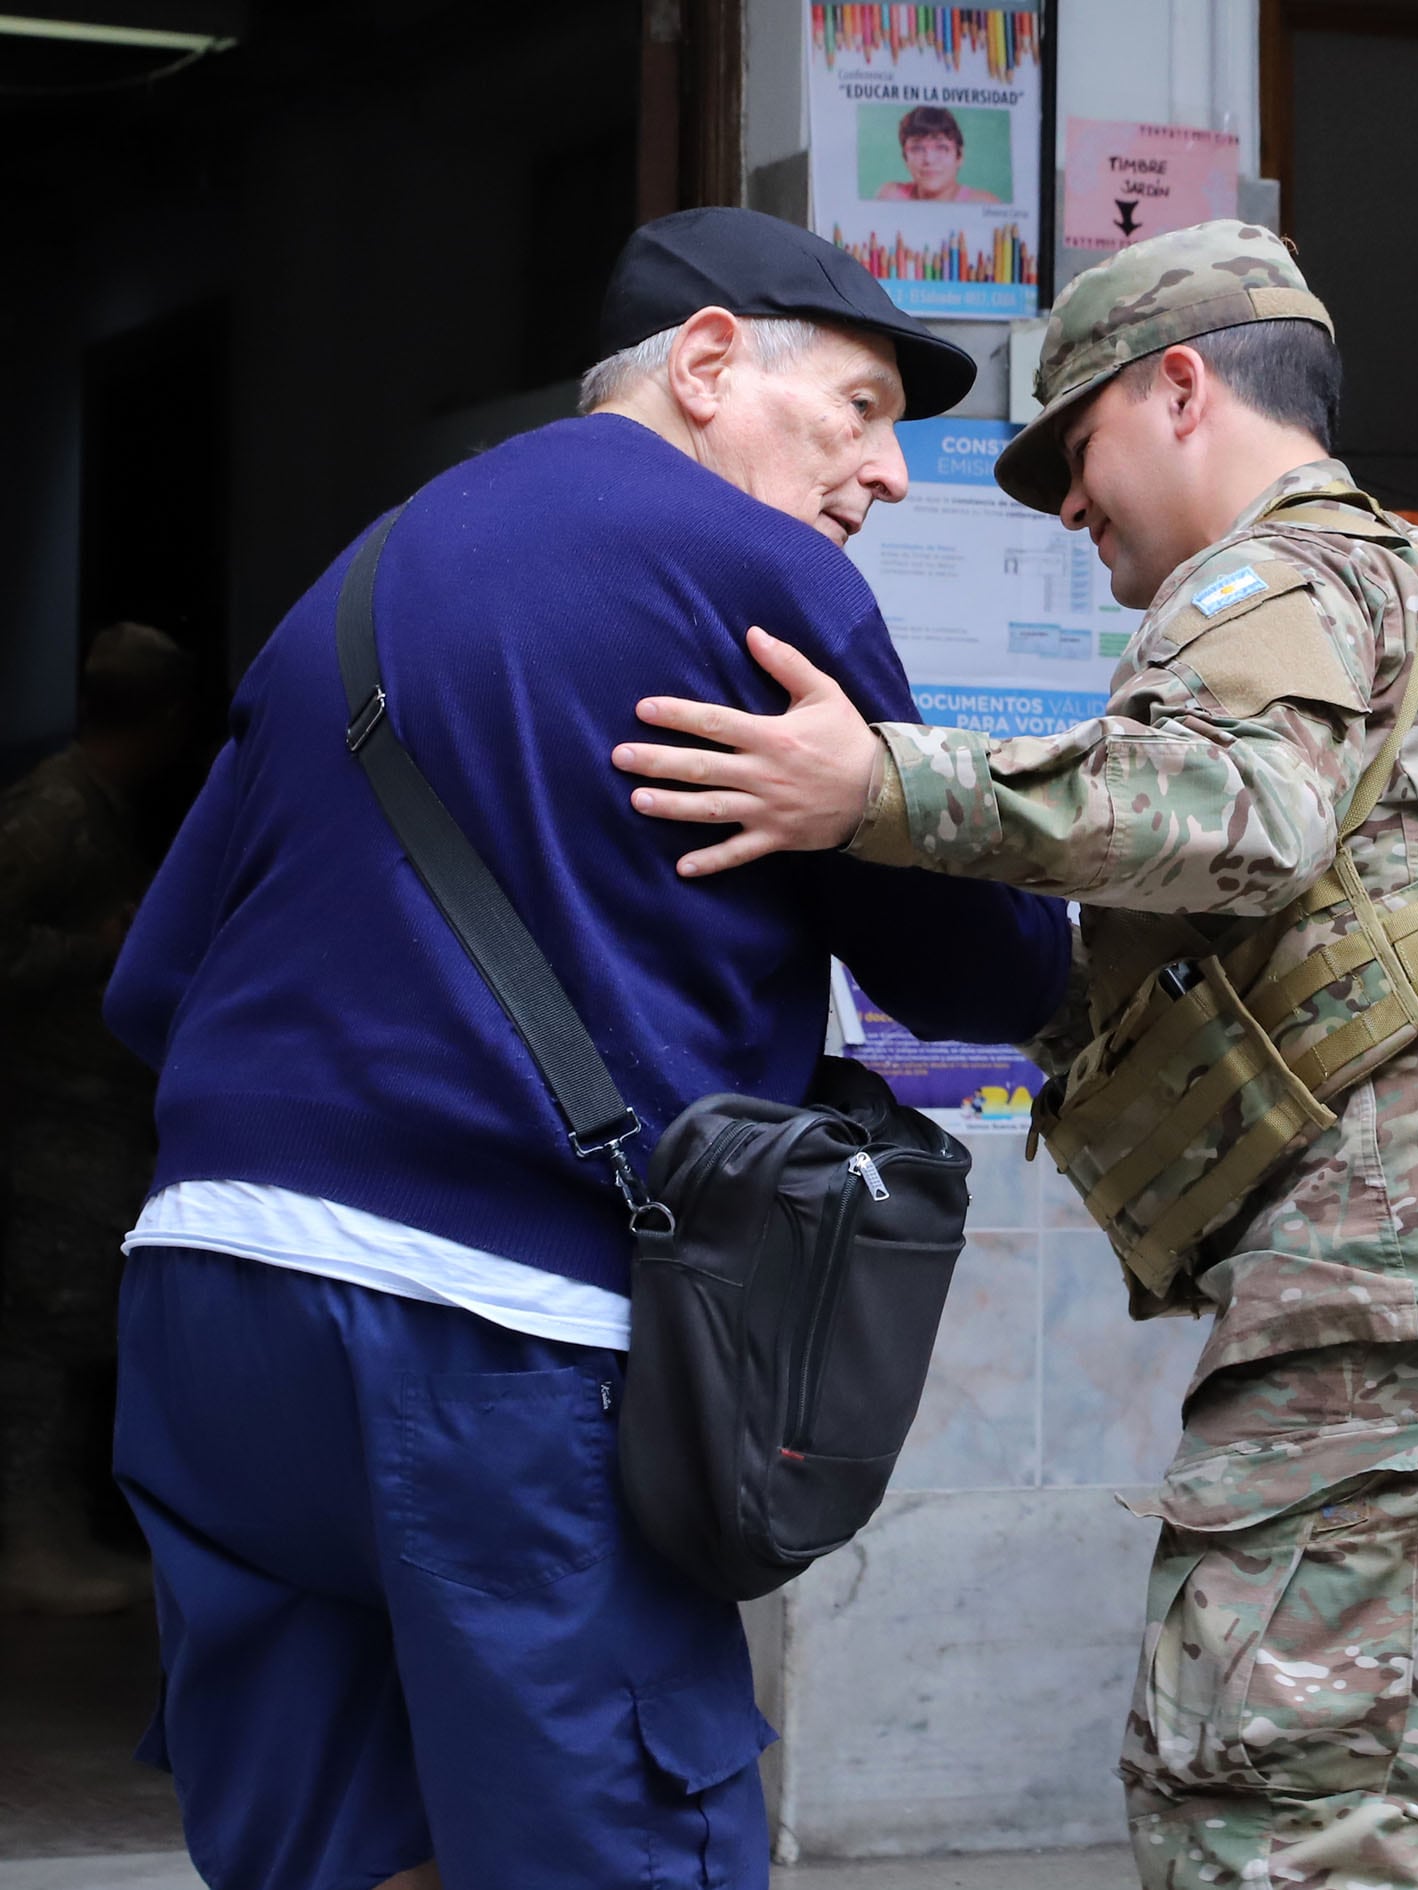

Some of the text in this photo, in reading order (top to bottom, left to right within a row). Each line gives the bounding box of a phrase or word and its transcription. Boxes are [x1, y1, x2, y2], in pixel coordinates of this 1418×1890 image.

[903, 86, 919, 100] EN
[923, 87, 938, 101] LA
[1108, 156, 1168, 174] TIMBRE
[938, 457, 995, 476] EMISI
[957, 713, 1009, 732] PARA
